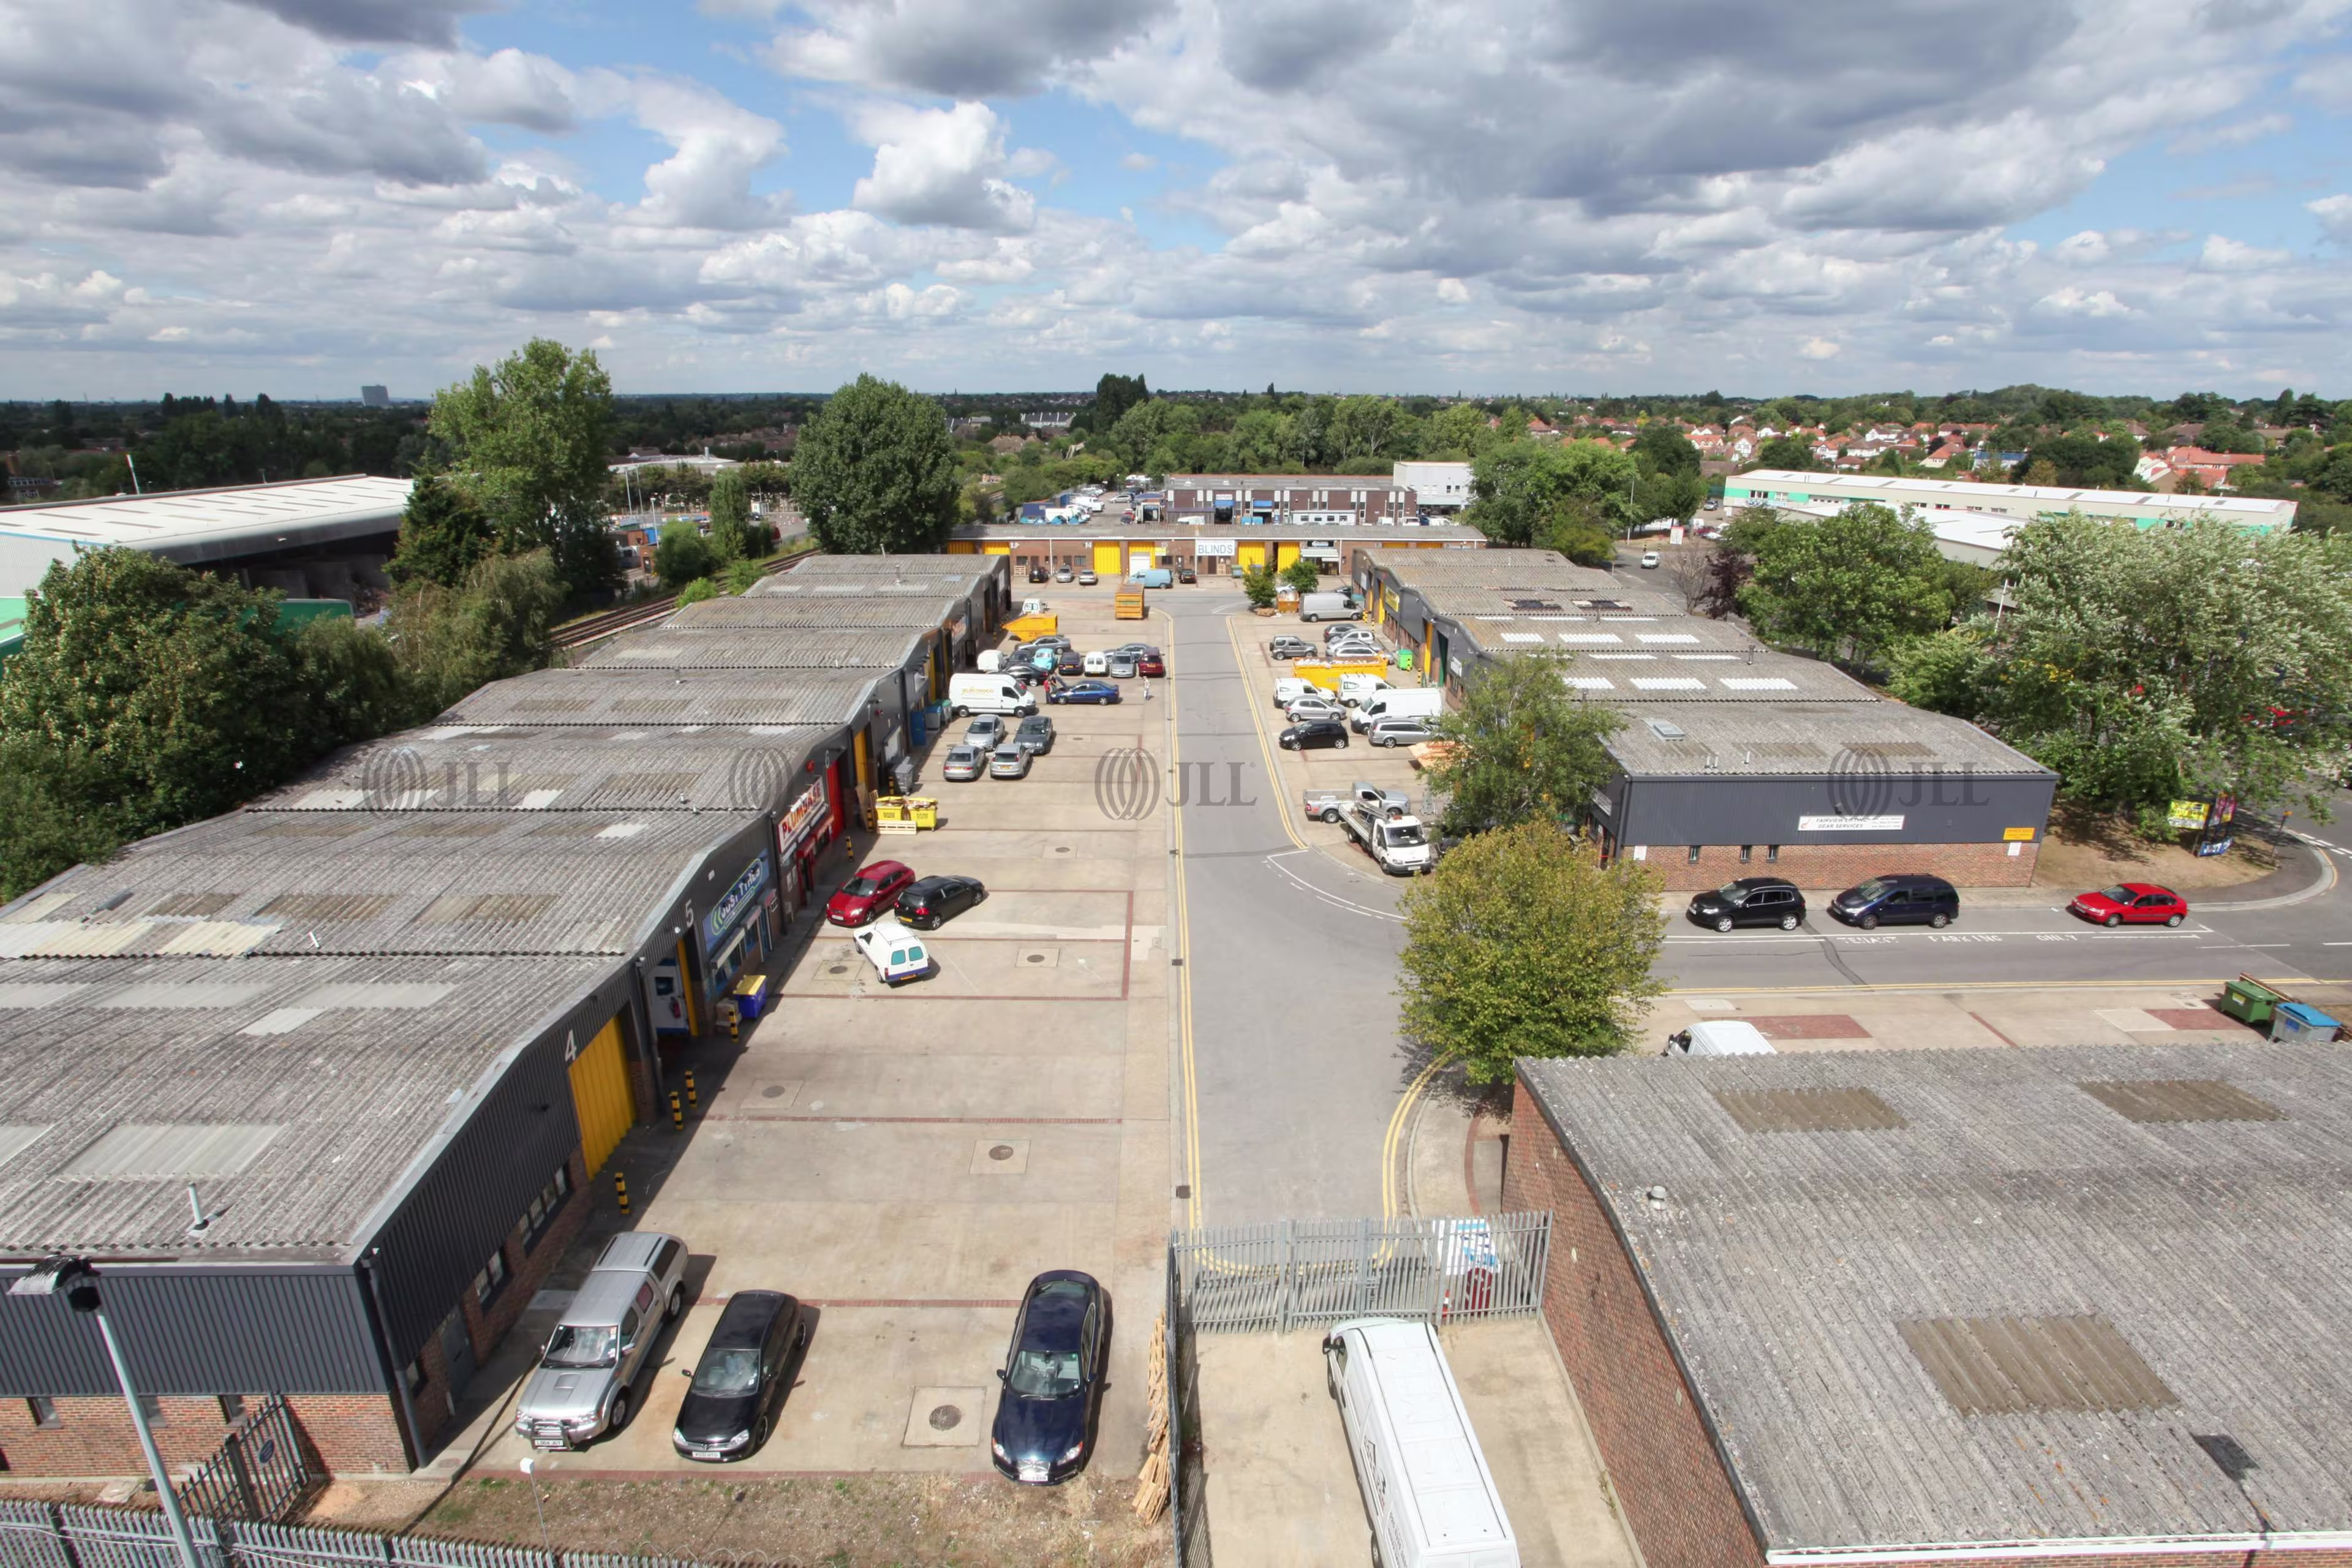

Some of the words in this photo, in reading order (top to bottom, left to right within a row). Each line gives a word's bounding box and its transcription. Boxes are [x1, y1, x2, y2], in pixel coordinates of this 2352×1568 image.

[1197, 545, 1233, 554] BLINDS
[782, 782, 821, 838] PLUMBASE
[685, 899, 694, 928] 5
[565, 1029, 577, 1061] 4
